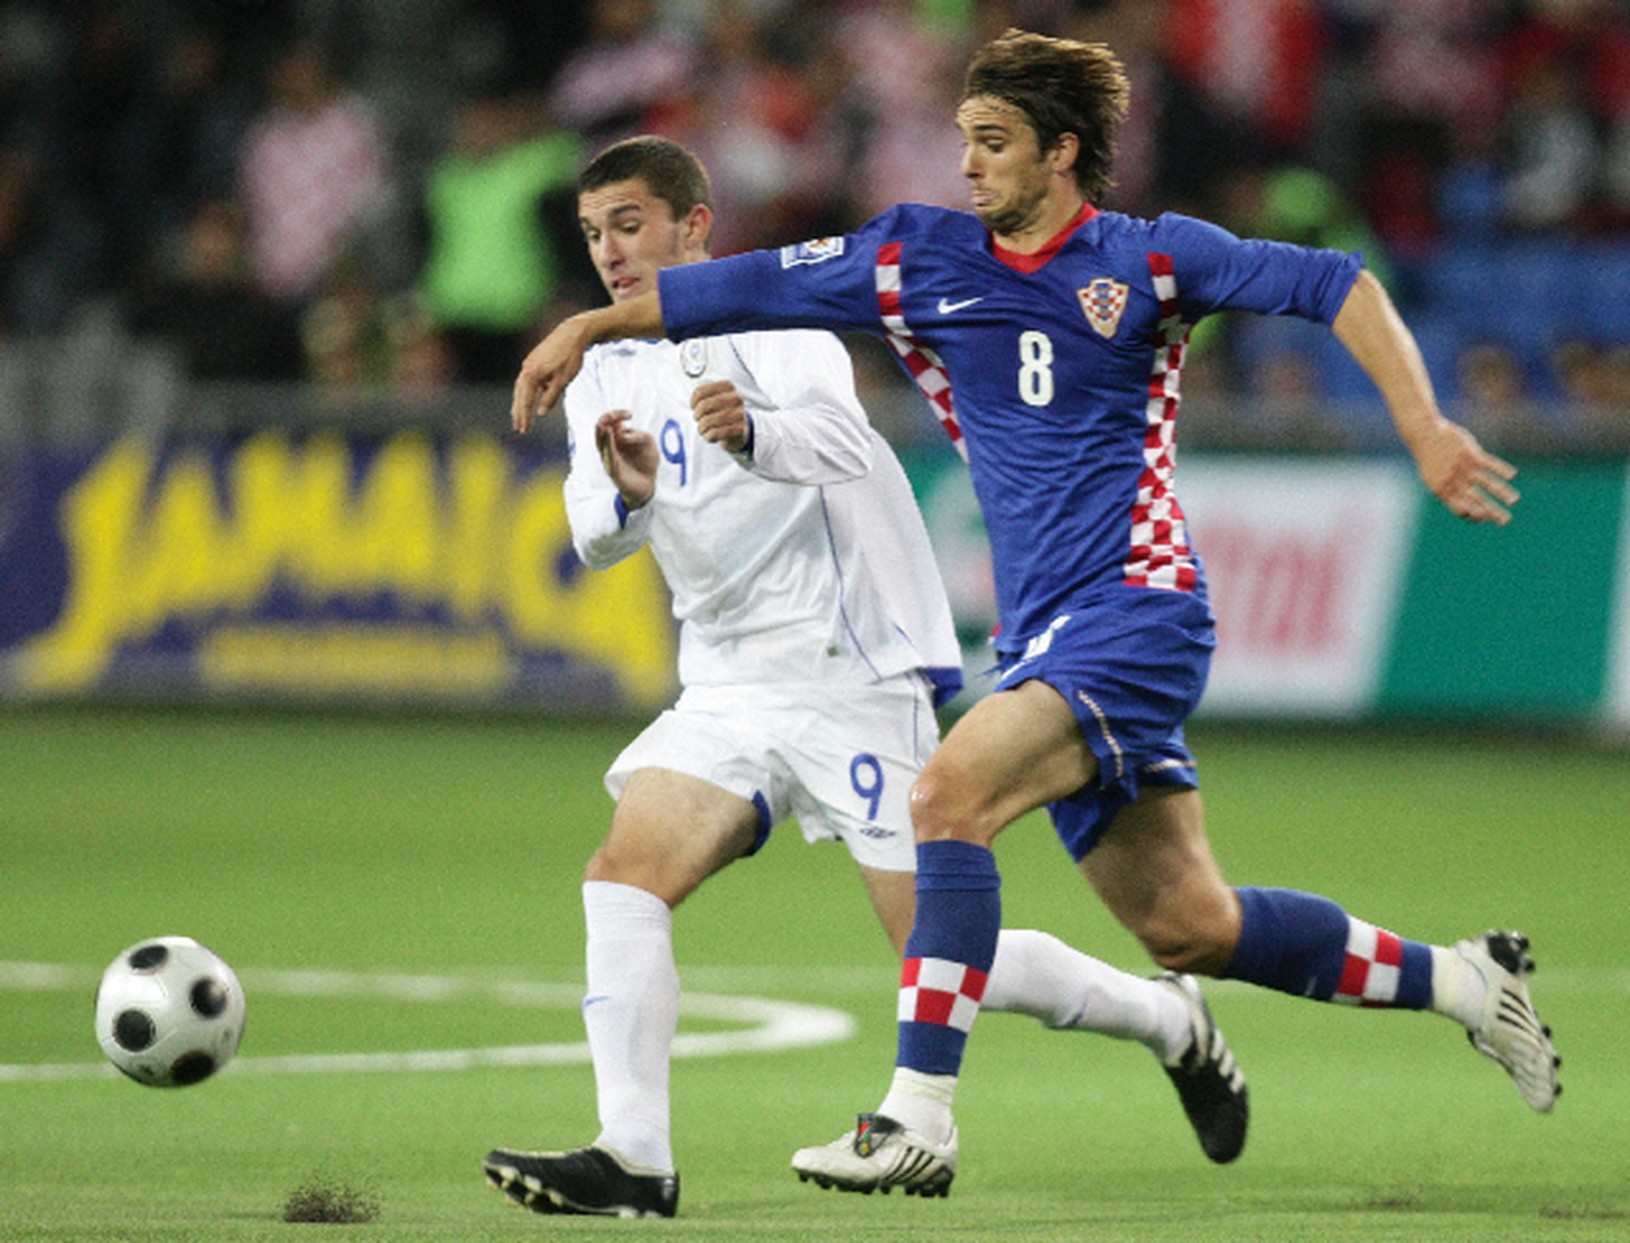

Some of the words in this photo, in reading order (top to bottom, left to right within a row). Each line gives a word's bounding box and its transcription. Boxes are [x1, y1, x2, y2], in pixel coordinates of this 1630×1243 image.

[1018, 330, 1054, 407] 8
[660, 418, 687, 488] 9
[850, 752, 884, 821] 9
